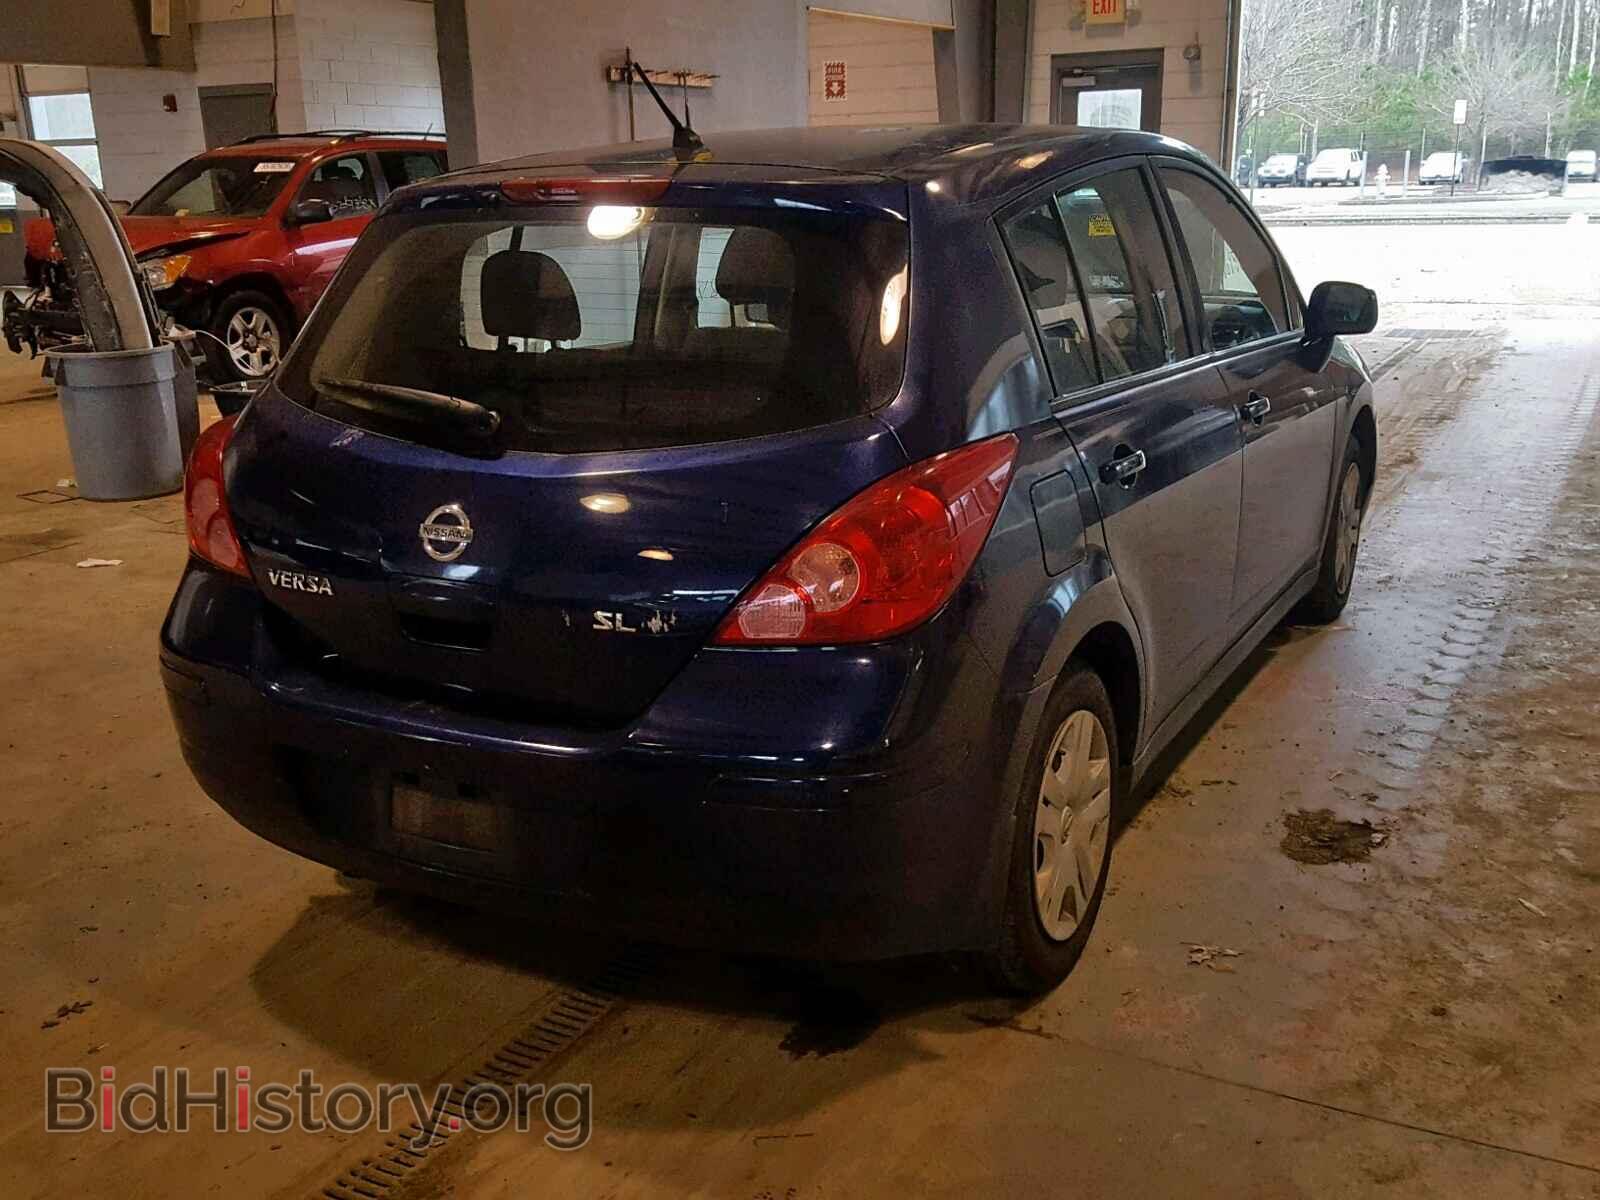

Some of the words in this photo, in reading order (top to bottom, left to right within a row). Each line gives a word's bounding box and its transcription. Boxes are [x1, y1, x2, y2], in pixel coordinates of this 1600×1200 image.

[1092, 0, 1118, 15] EXIT
[424, 527, 468, 539] NISSAN
[267, 568, 334, 596] VERSA
[592, 610, 637, 632] SL
